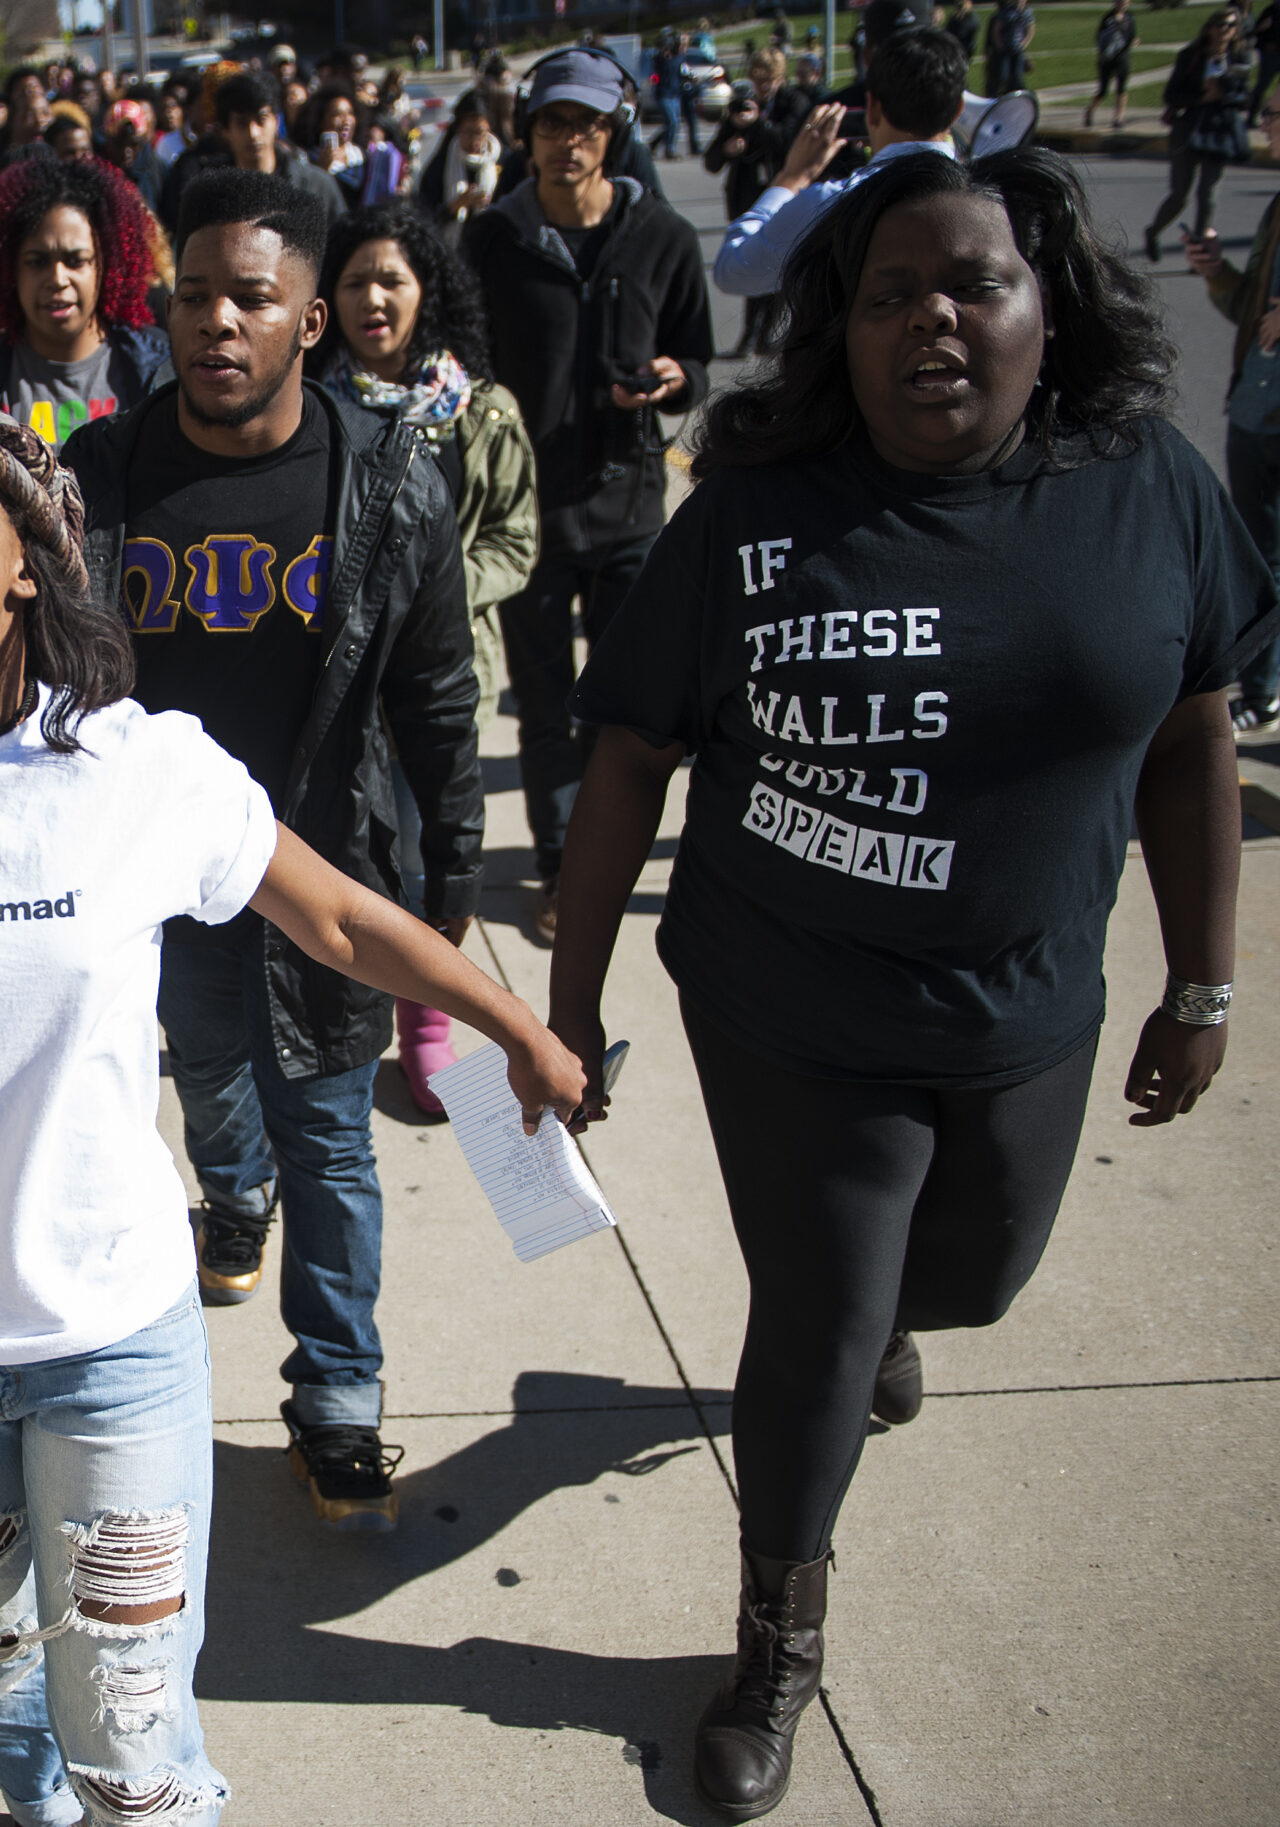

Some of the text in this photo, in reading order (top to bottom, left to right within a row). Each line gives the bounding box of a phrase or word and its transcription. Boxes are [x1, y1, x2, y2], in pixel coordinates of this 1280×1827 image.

[738, 537, 793, 596] IF
[744, 607, 942, 673] THESE
[746, 680, 949, 745] WALLS
[750, 791, 949, 886] SPEAK
